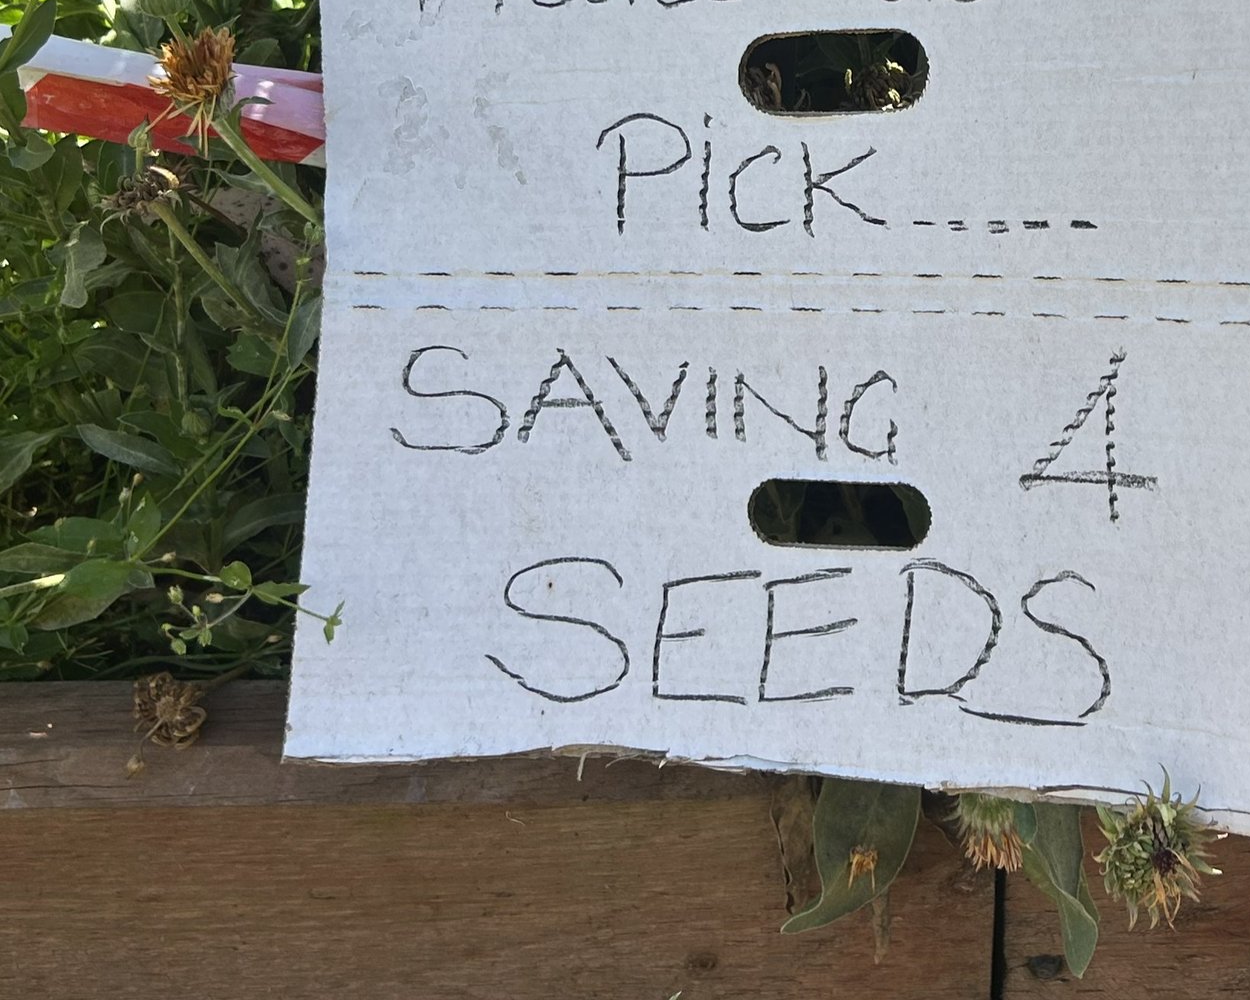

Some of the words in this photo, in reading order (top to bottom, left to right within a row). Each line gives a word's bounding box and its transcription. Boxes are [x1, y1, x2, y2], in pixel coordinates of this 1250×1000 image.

[389, 344, 899, 464] SAVING
[1018, 346, 1158, 523] 4
[484, 556, 1112, 727] SEEDS
